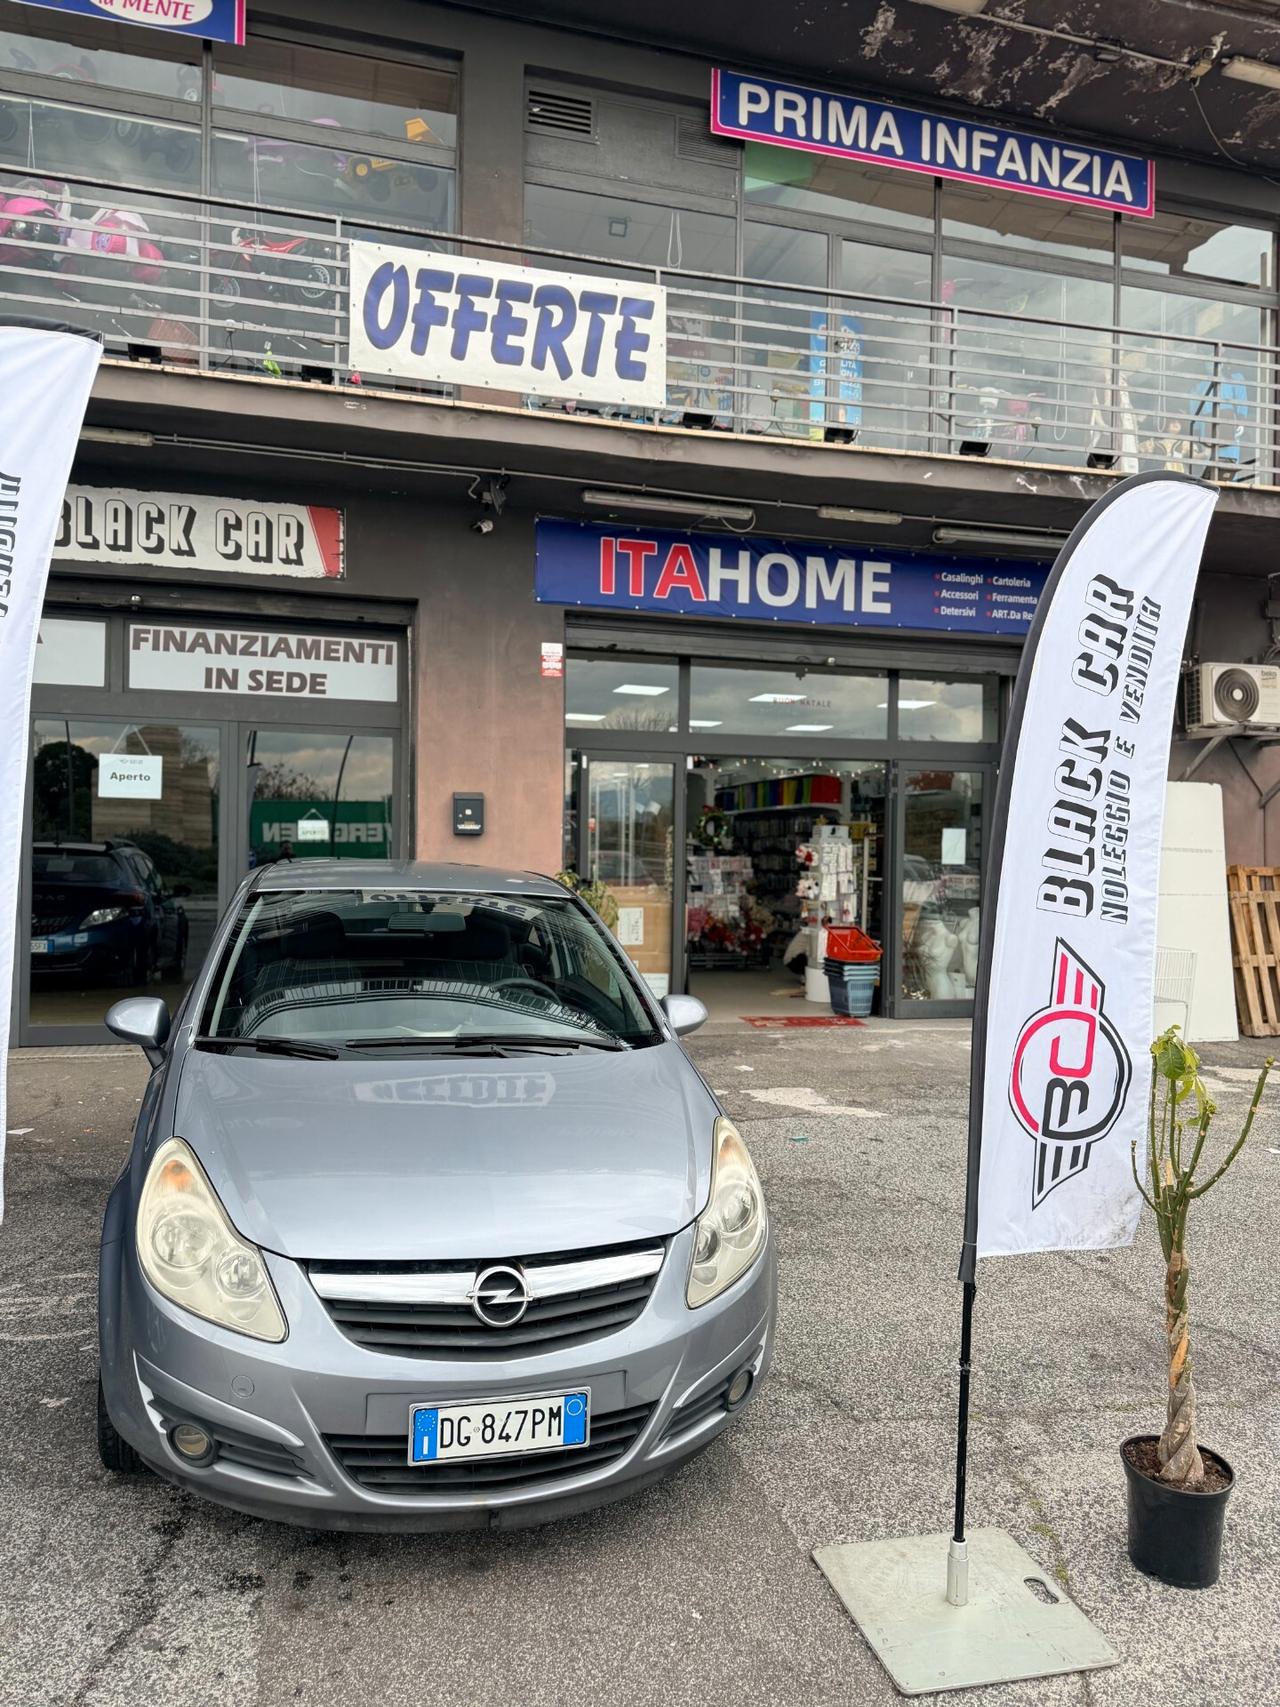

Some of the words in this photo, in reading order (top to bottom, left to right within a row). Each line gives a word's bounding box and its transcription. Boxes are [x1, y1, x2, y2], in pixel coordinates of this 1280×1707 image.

[122, 0, 193, 21] MENTE
[738, 82, 904, 156] PRIMA
[920, 118, 1134, 203] INFANZIA
[362, 260, 655, 382] OFFERTE
[215, 507, 305, 566] CAR
[599, 536, 893, 615] ITAHOME
[940, 589, 979, 601] Accessori
[941, 572, 984, 586] Casalinghi
[992, 576, 1031, 588] Cartoleria
[940, 606, 976, 617] Detersivi
[992, 593, 1038, 605] Ferramenta
[131, 626, 395, 666] FINANZIAMENTI
[1071, 573, 1135, 697] CAR
[1118, 595, 1162, 725] VENDITA
[203, 667, 239, 691] IN
[248, 669, 328, 696] SEDE
[1113, 735, 1136, 759] E
[109, 770, 151, 784] Aperto
[1036, 717, 1112, 918] BLACK
[1099, 769, 1131, 925] NOLEGGIO
[439, 1415, 472, 1449] DG
[481, 1404, 562, 1445] 847PM
